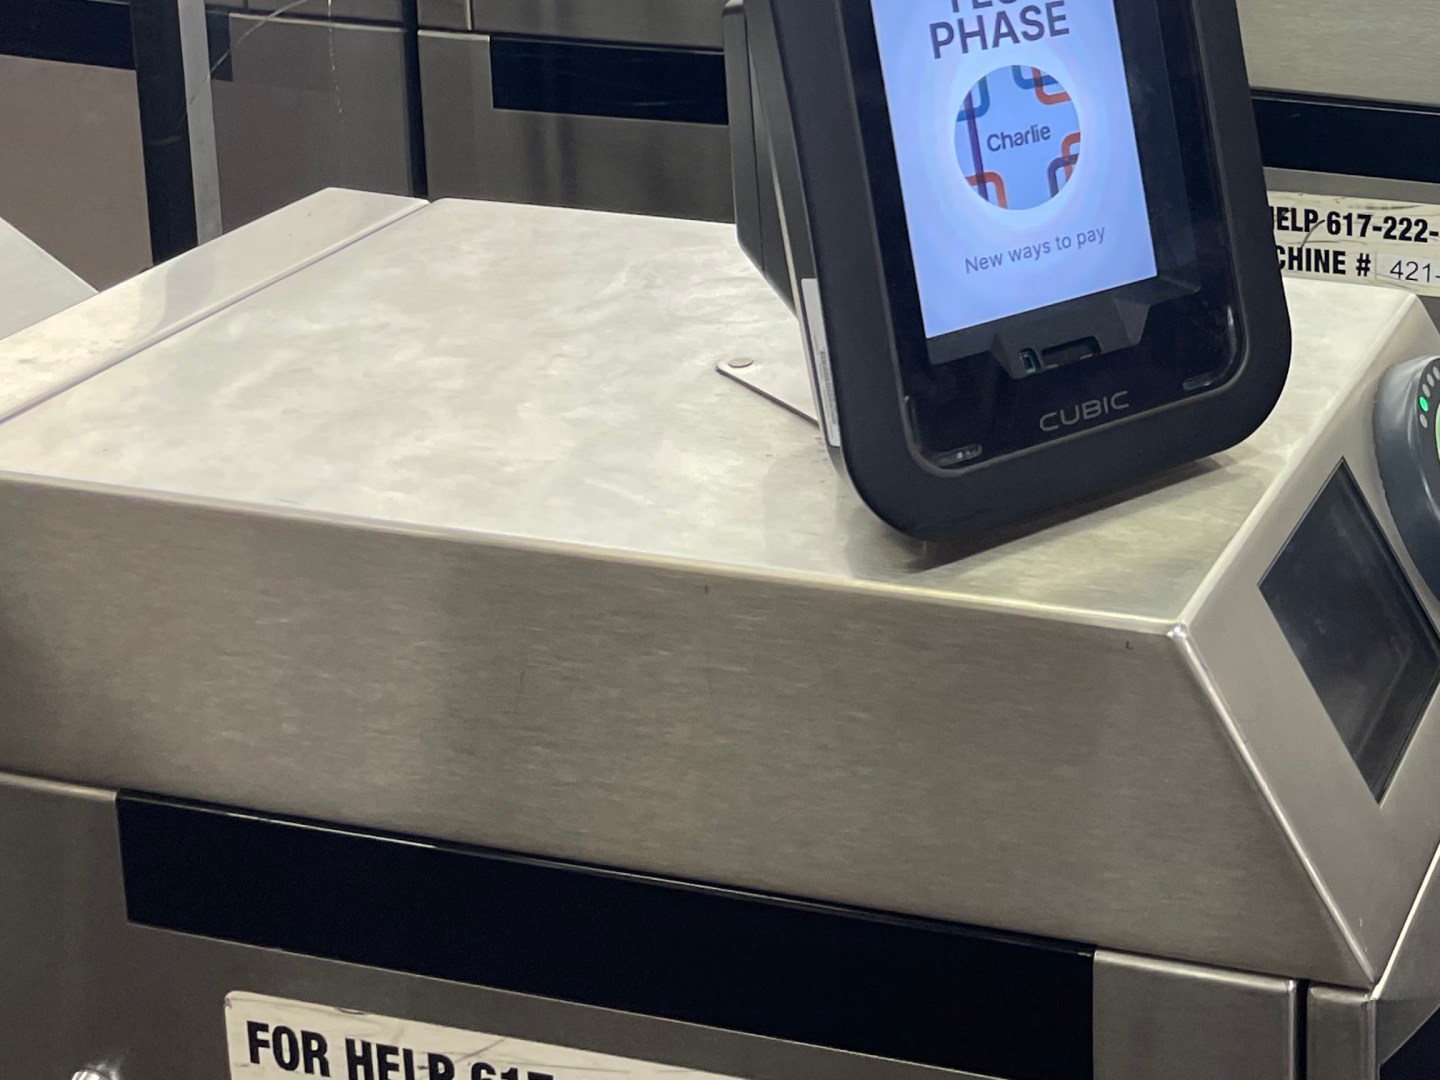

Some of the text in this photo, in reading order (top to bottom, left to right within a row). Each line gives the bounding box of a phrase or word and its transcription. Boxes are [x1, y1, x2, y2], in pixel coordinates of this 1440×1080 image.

[929, 0, 1070, 60] PHASE
[986, 124, 1051, 152] Charlie
[965, 226, 1106, 274] New ways to pay
[1356, 252, 1371, 277] #
[1039, 390, 1130, 432] CUBIC
[246, 1020, 456, 1080] FOR HELP
